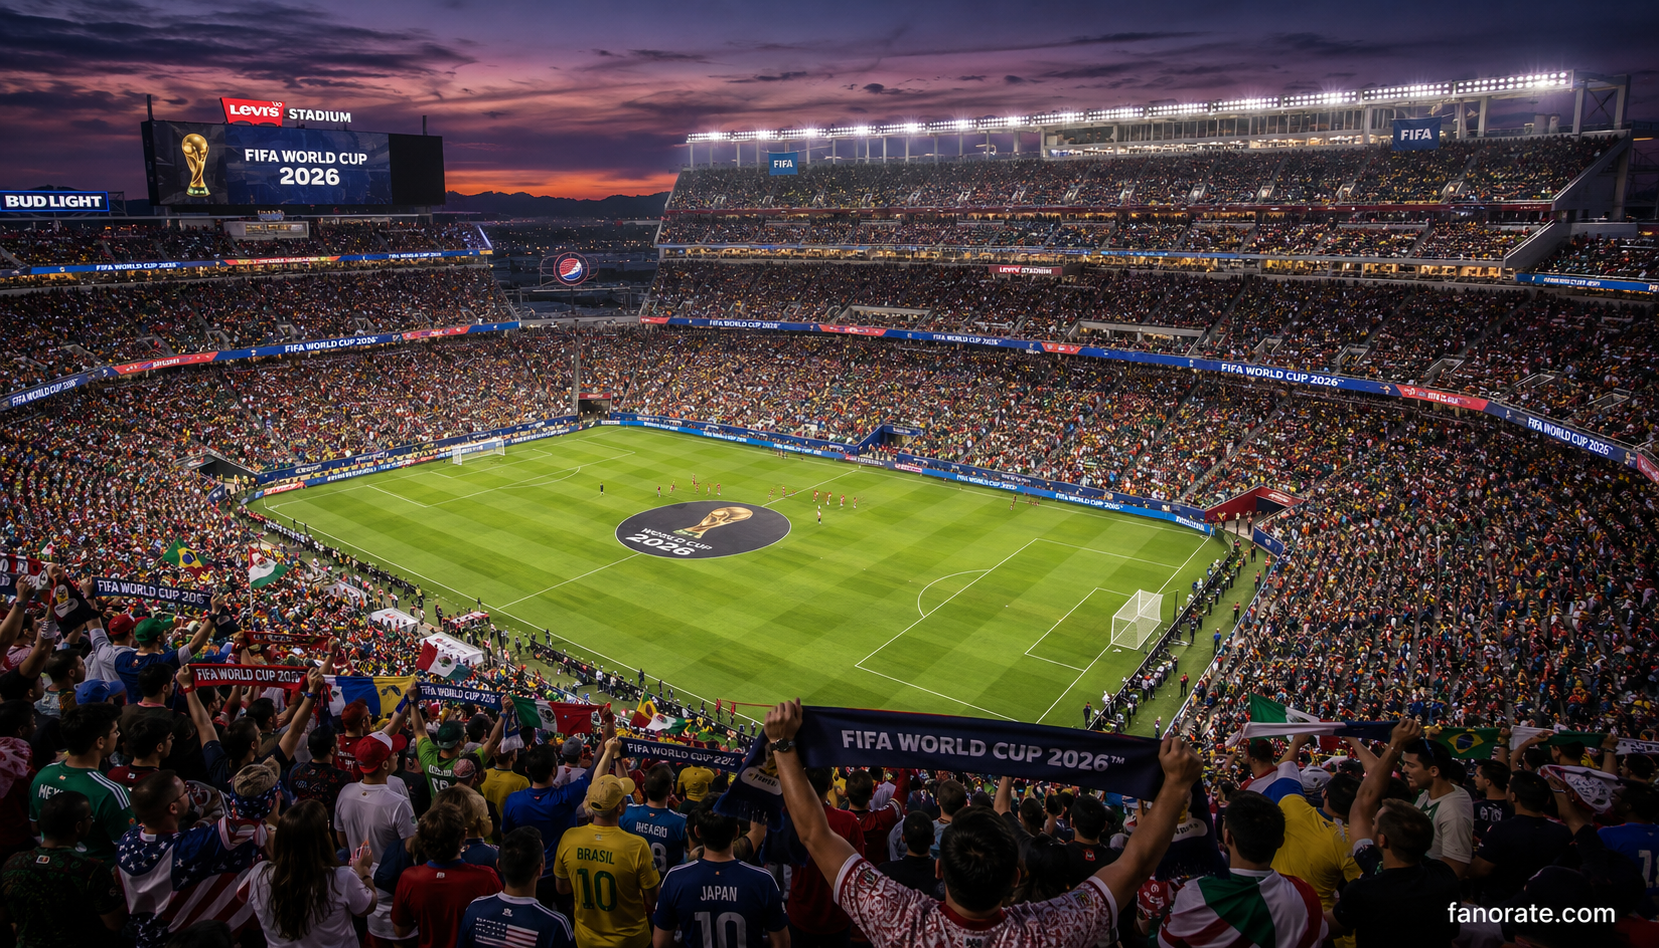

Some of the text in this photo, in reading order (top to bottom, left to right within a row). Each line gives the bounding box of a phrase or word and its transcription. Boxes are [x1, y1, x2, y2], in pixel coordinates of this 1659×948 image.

[288, 108, 352, 123] STADIUM
[1400, 128, 1433, 141] FIFA
[244, 149, 368, 165] FIFA WORLD CUP
[773, 159, 793, 168] FIFA
[279, 166, 340, 186] 2026
[5, 195, 102, 208] BUD LIGHT
[284, 343, 305, 353] FIFA
[305, 339, 338, 350] WORLD
[338, 338, 356, 347] CUP
[1221, 363, 1244, 374] FIFA
[1245, 366, 1284, 379] WORLD
[1285, 372, 1309, 383] CUP
[1527, 416, 1543, 433] FIFA
[1544, 422, 1571, 441] WORLD
[1571, 432, 1588, 447] CUP
[625, 533, 697, 556] 2026
[686, 540, 713, 551] CUP
[97, 580, 119, 593] FIFA
[120, 581, 156, 596] WORLD
[158, 587, 180, 600] CUP
[195, 668, 218, 681] FIFA
[217, 668, 253, 681] WORLD
[255, 669, 275, 681] CUP
[464, 691, 480, 701] CUP
[627, 743, 650, 754] FIFA
[650, 746, 689, 759] WORLD
[841, 729, 893, 751] FIFA
[897, 732, 987, 757] WORLD
[992, 741, 1043, 762] CUP
[577, 847, 615, 865] BRASIL
[576, 868, 618, 912] 10
[700, 885, 738, 902] JAPAN
[694, 911, 747, 948] 10
